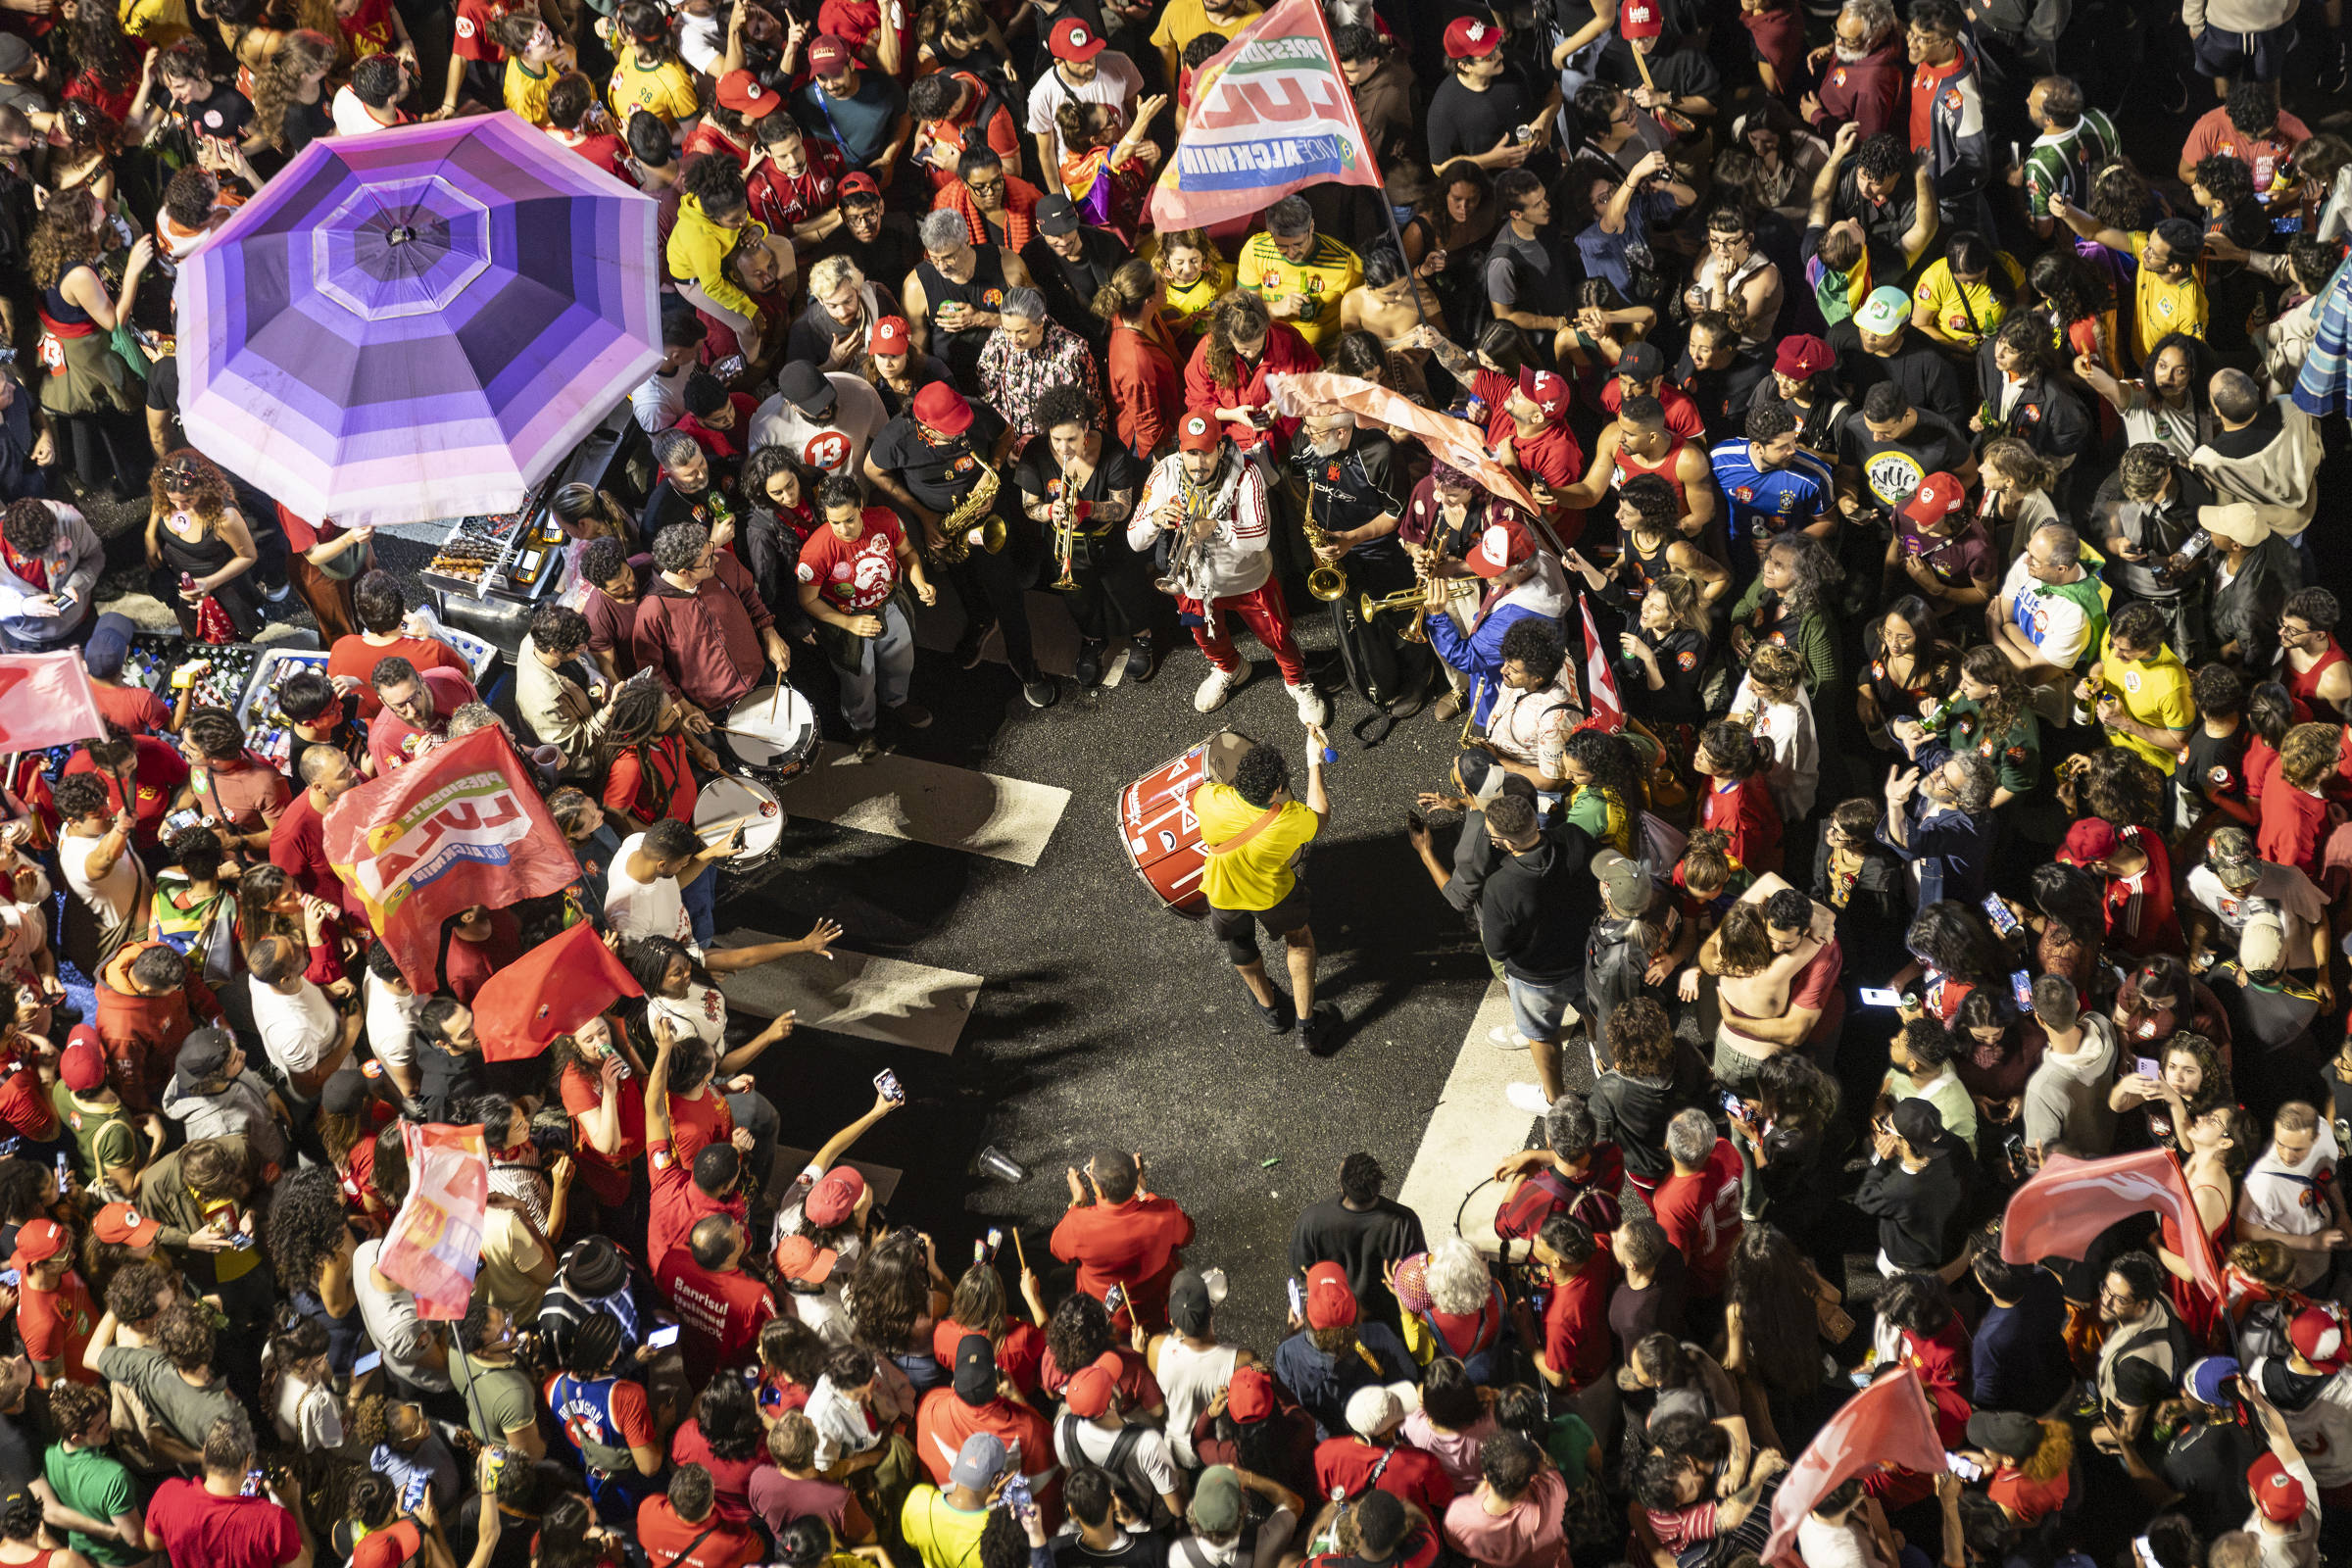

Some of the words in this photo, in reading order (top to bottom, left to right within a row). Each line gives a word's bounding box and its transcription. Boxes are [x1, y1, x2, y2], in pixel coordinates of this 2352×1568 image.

[810, 436, 843, 467] 13
[849, 584, 894, 608] LUL
[2018, 585, 2041, 612] SUS
[1701, 1176, 1741, 1255] 13
[674, 1276, 729, 1315] Banrisul
